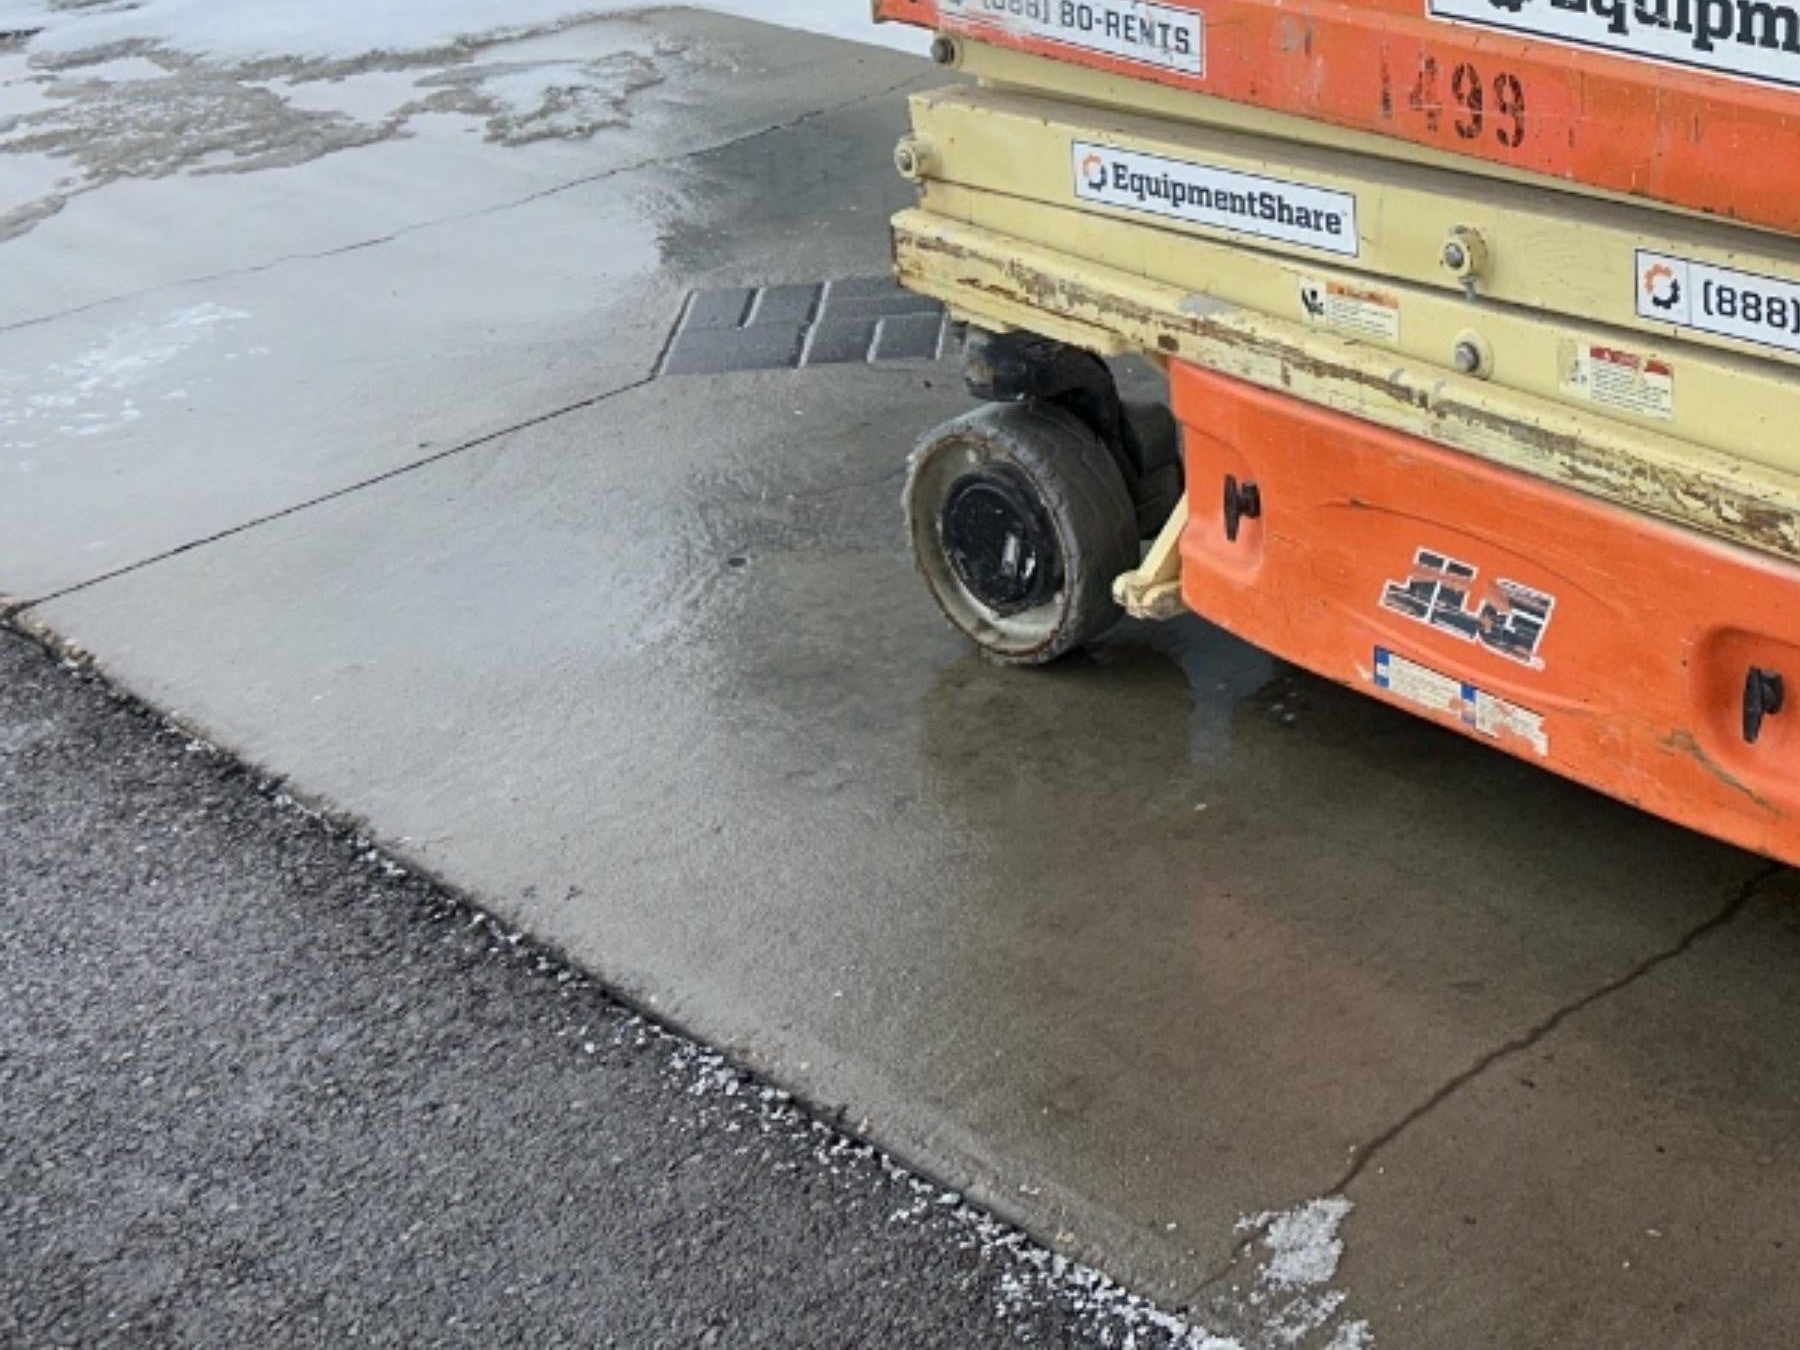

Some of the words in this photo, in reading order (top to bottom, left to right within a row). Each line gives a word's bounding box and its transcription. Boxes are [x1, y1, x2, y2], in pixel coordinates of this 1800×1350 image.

[1058, 0, 1190, 55] 80-RENTS
[1380, 43, 1526, 148] 1499
[1111, 161, 1342, 236] EquipmentShare
[1703, 280, 1800, 334] (888)
